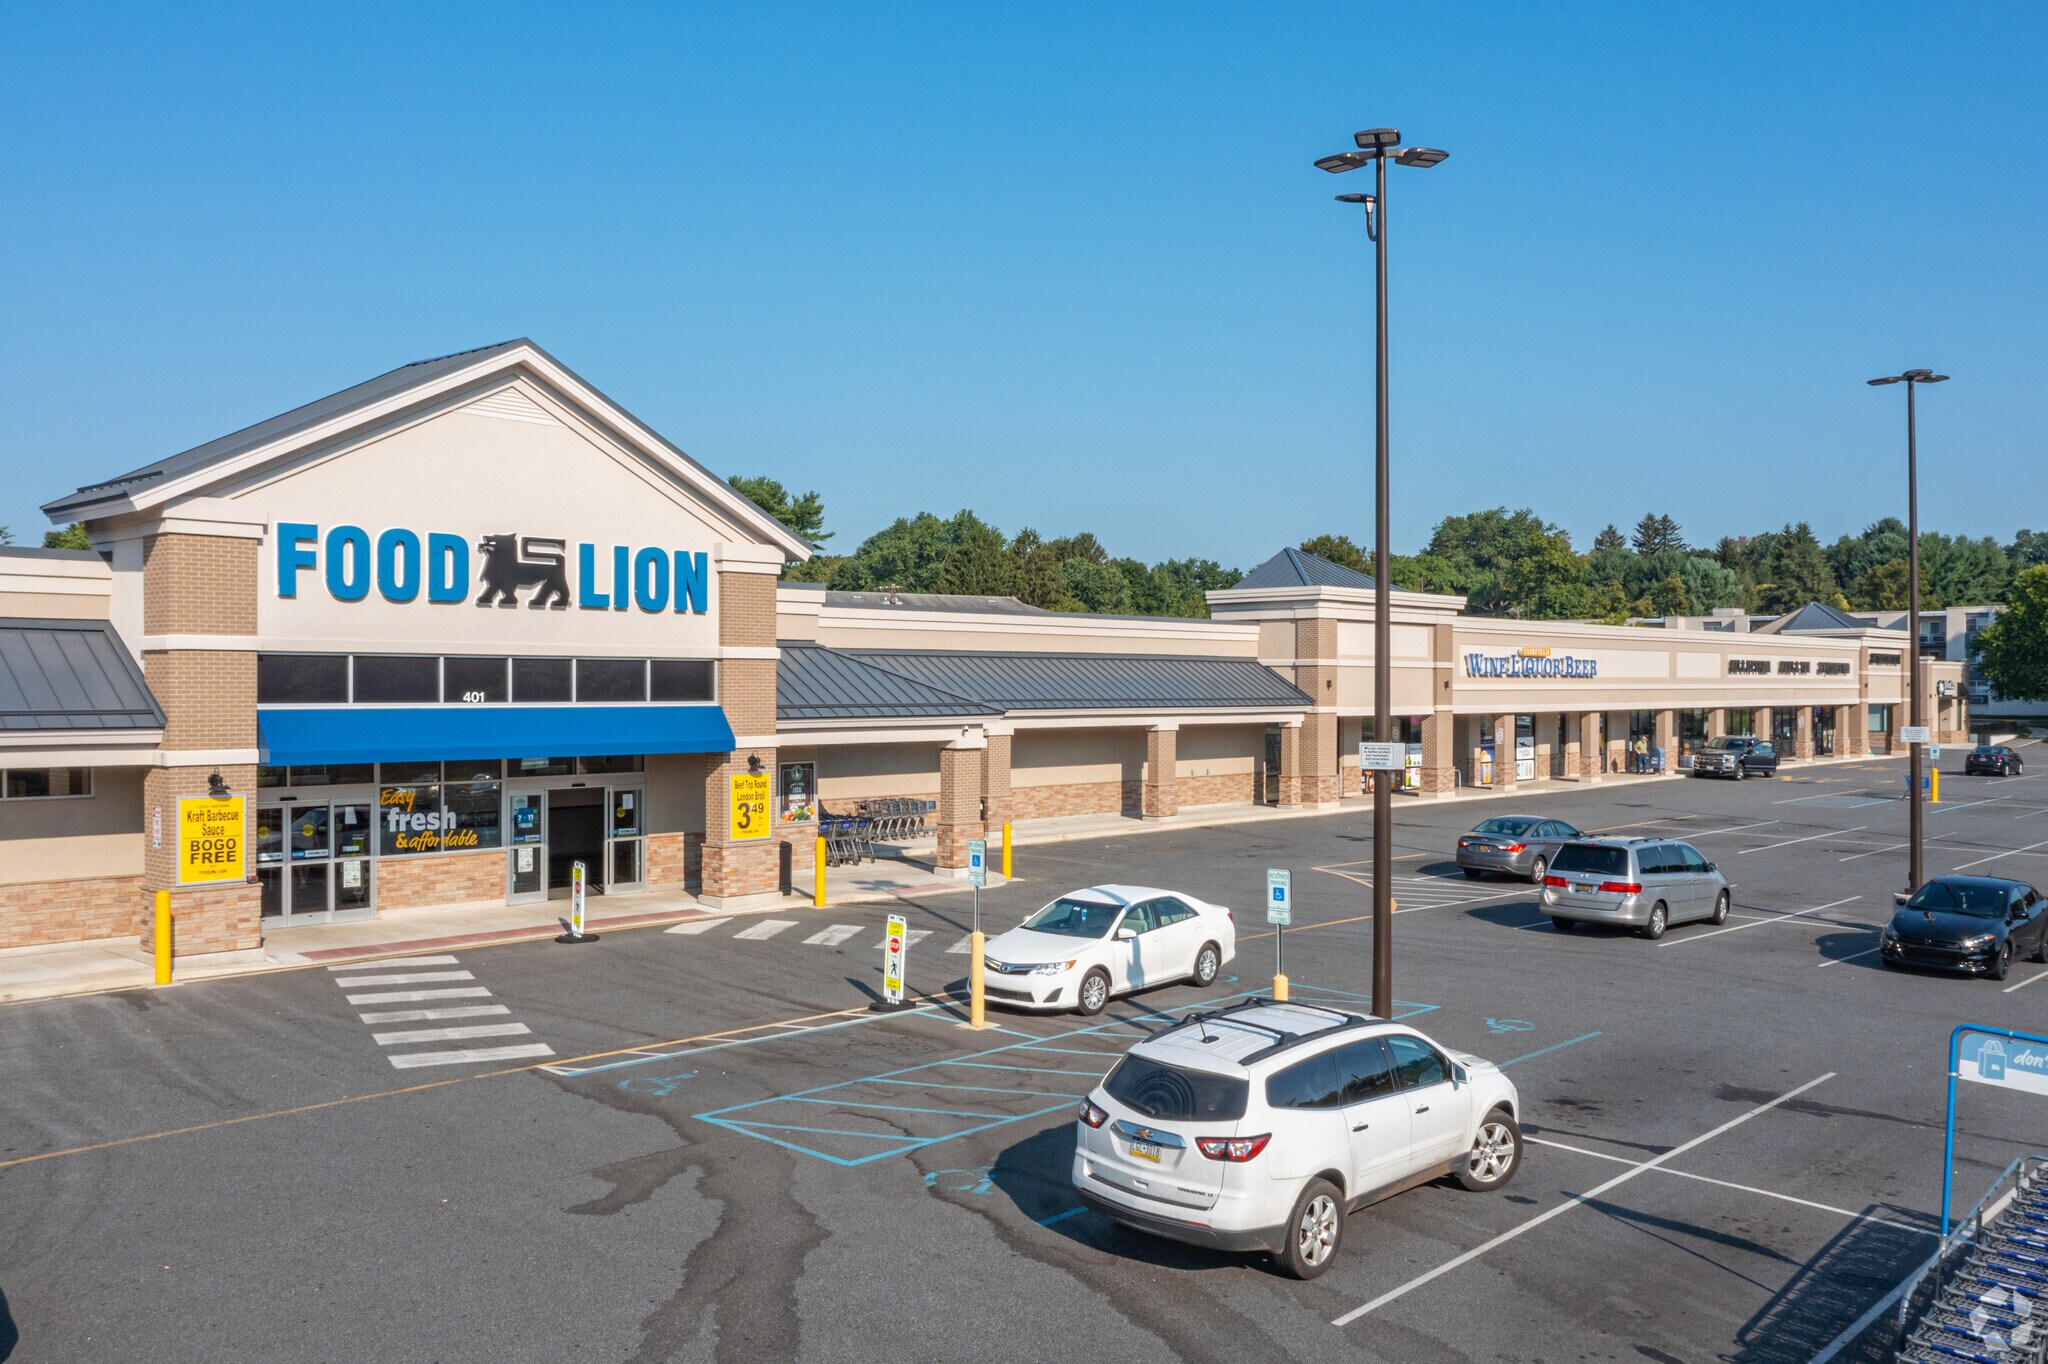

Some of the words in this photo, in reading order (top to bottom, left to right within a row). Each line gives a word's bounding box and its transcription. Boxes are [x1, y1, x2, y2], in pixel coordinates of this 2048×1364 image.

[274, 521, 470, 603] FOOD
[577, 542, 708, 613] LION
[1468, 653, 1507, 675] WINE
[1510, 654, 1561, 676] LIQUOR
[1565, 656, 1598, 676] BEER
[463, 691, 486, 703] 401
[745, 780, 753, 791] Top
[380, 788, 416, 813] Easy
[187, 810, 205, 822] Kraft
[206, 809, 239, 822] Barbecue
[388, 805, 456, 832] fresh
[737, 802, 751, 829] 3
[751, 803, 764, 813] 49
[202, 823, 225, 836] Sauce
[190, 838, 236, 852] BOGO
[395, 833, 408, 848] &
[190, 851, 236, 864] FREE
